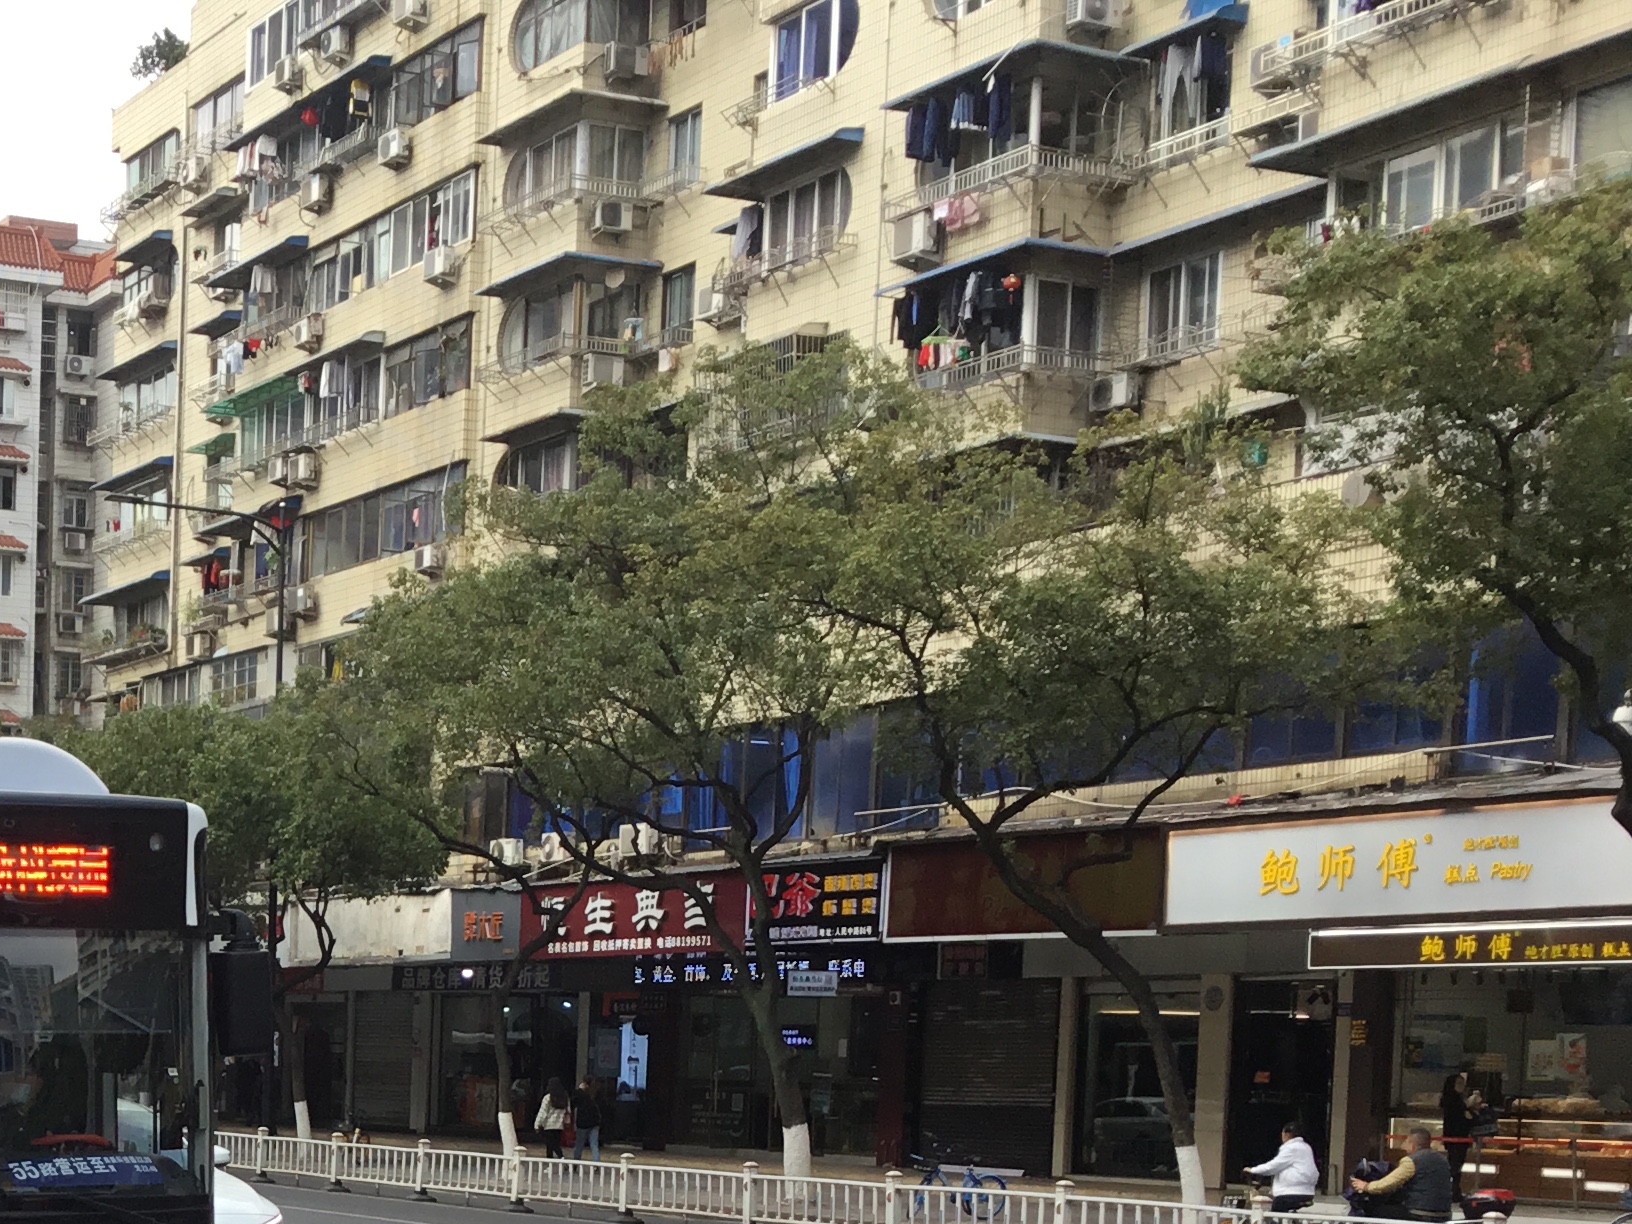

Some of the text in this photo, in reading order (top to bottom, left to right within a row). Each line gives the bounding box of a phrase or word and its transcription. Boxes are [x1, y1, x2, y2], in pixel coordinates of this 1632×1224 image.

[1259, 838, 1418, 896] 鲍师傅
[1444, 861, 1534, 885] 糕点 Pastry
[1419, 933, 1513, 962] 鲍师傅
[402, 967, 462, 989] 品牌仓库
